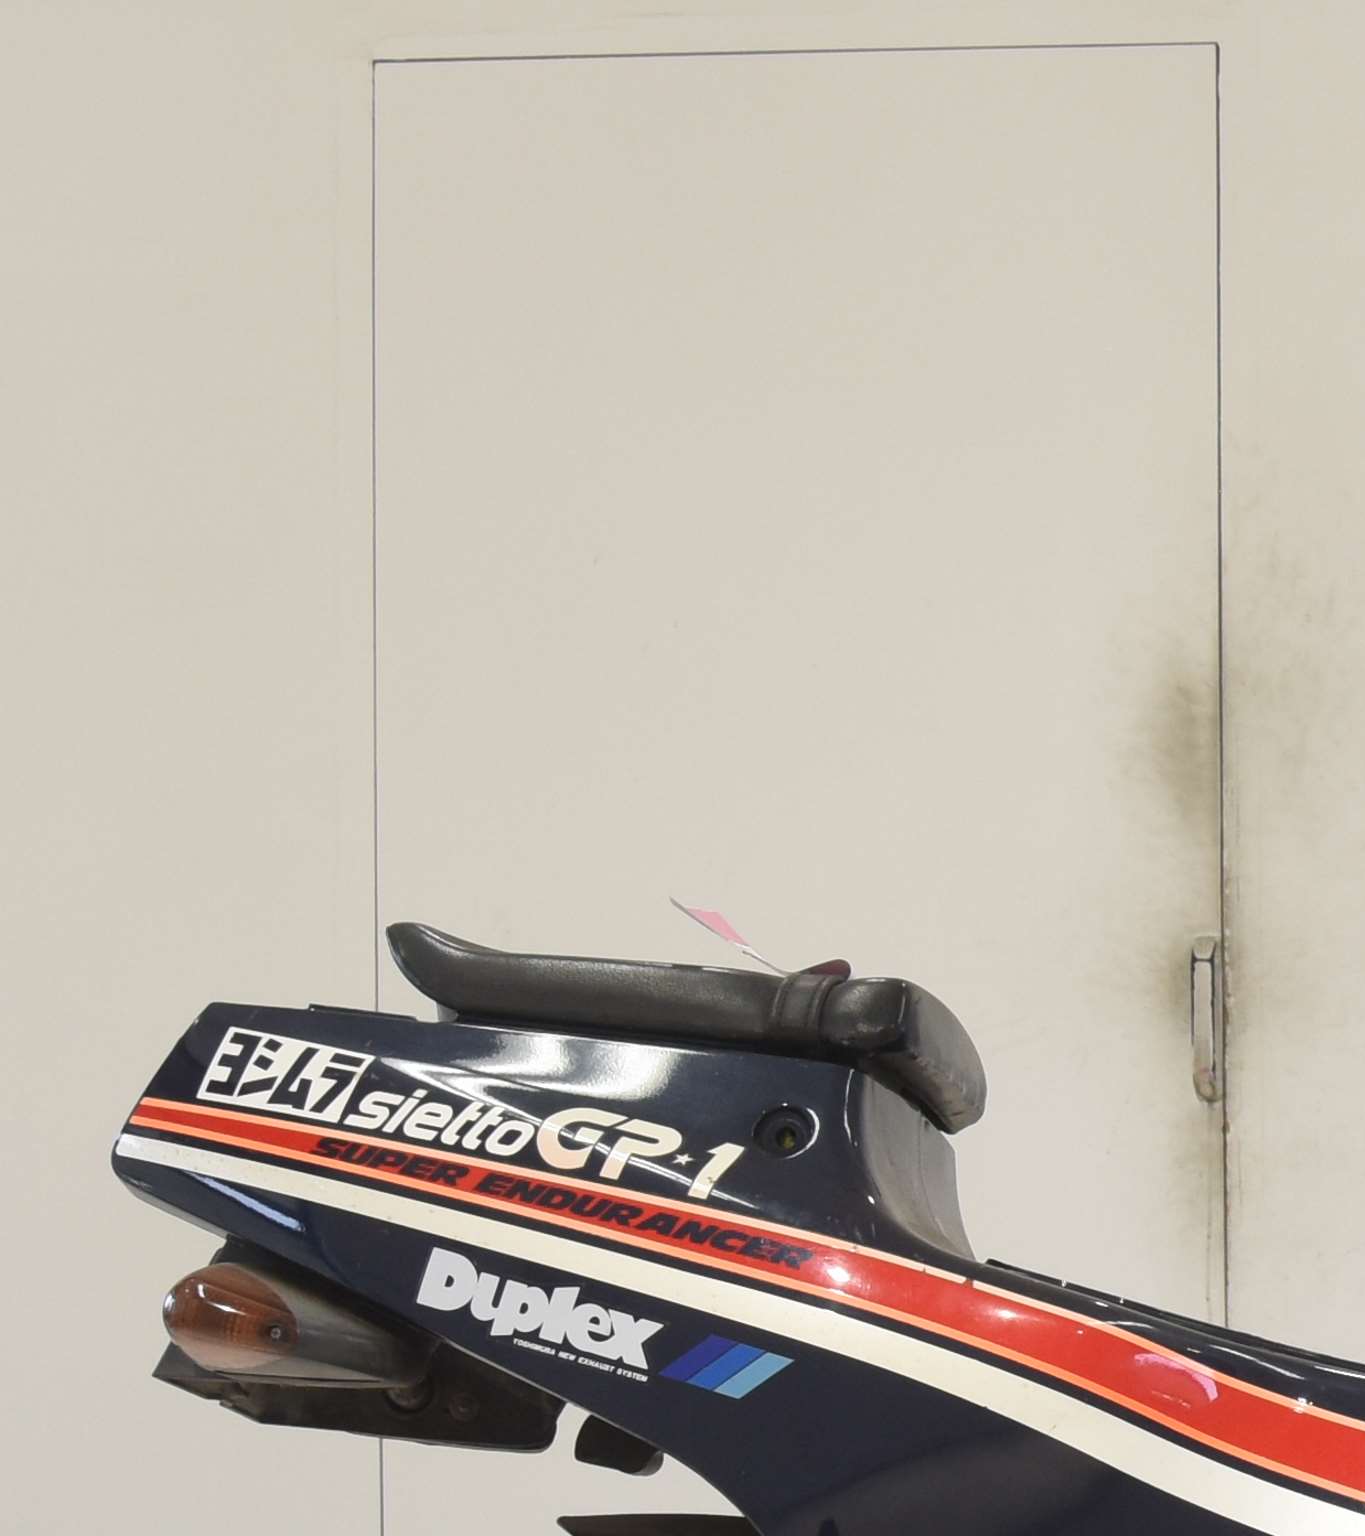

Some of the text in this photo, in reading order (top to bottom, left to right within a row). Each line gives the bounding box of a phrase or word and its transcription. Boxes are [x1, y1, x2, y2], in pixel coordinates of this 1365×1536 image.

[205, 1031, 367, 1114] ヨシムラ
[343, 1089, 536, 1155] sietto
[308, 1137, 814, 1268] SUPER ENDURANCER
[416, 1246, 664, 1369] Duplex
